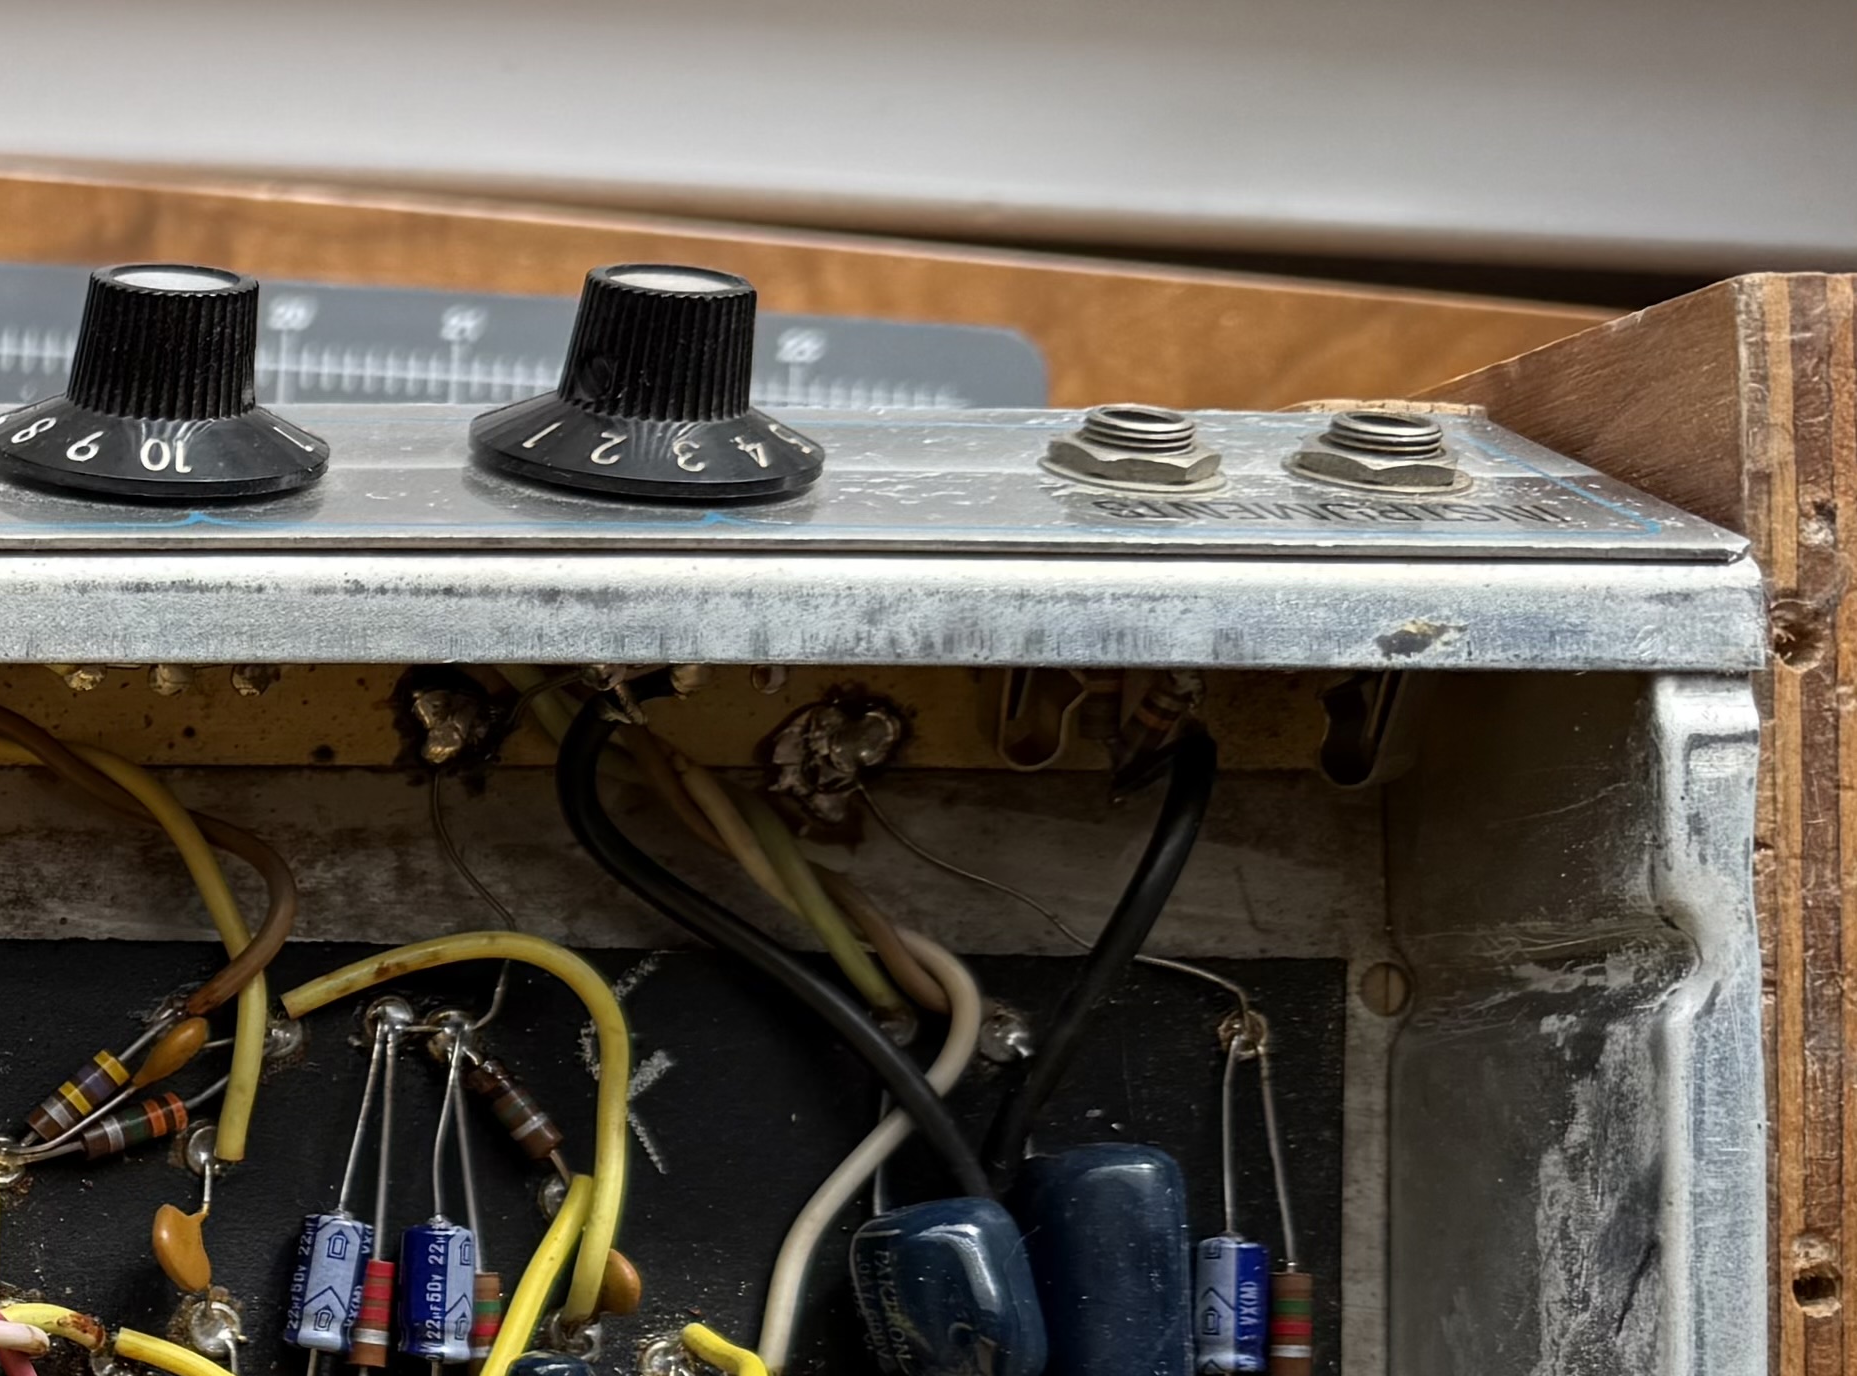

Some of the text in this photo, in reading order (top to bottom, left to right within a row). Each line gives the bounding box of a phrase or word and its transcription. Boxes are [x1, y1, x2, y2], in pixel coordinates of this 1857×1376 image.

[10, 417, 57, 444] 8
[66, 431, 104, 462] 9
[522, 421, 562, 448] 1
[139, 437, 193, 474] 10
[590, 432, 627, 465] 2
[670, 438, 706, 473] 3
[729, 434, 769, 468] 4
[1090, 500, 1566, 524] INSTRUMENTS
[1238, 1280, 1259, 1326] VX(M)
